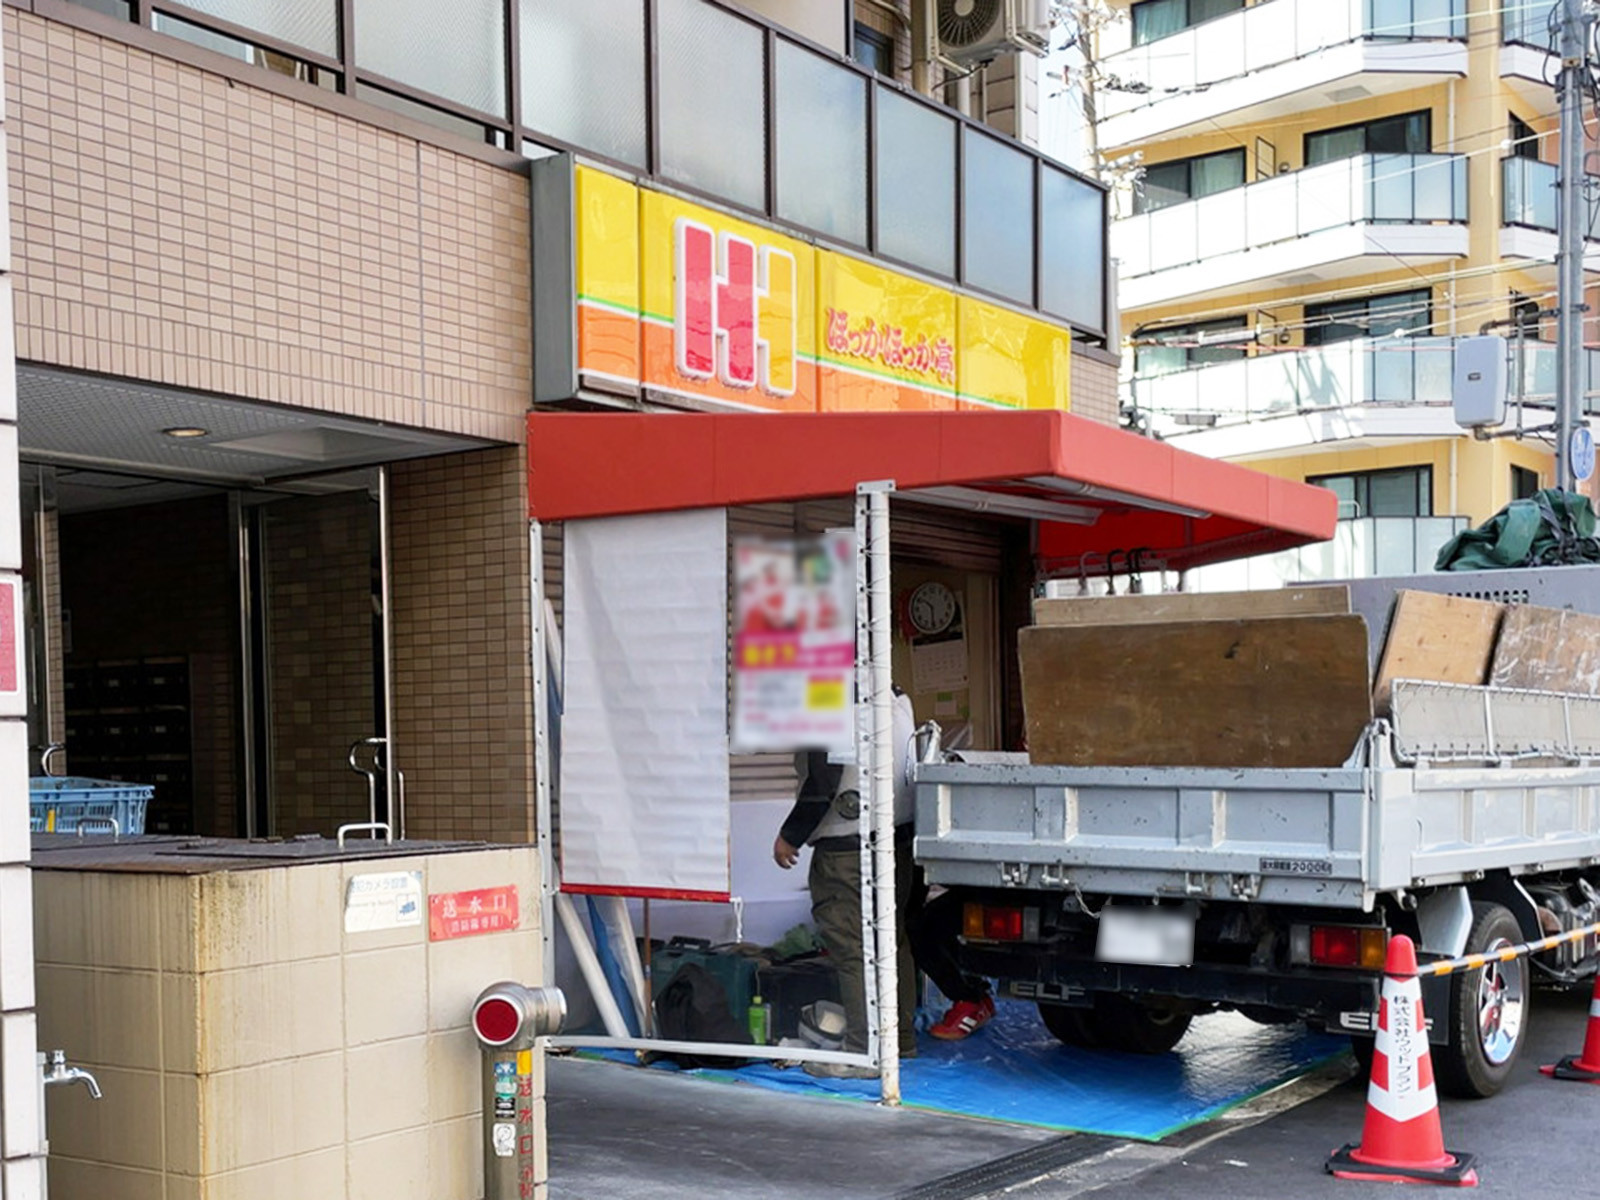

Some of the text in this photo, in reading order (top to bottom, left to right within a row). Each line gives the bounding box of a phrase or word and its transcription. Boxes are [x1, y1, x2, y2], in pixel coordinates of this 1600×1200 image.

[826, 307, 955, 381] ほっかほっか亭
[442, 894, 507, 919] 送水口
